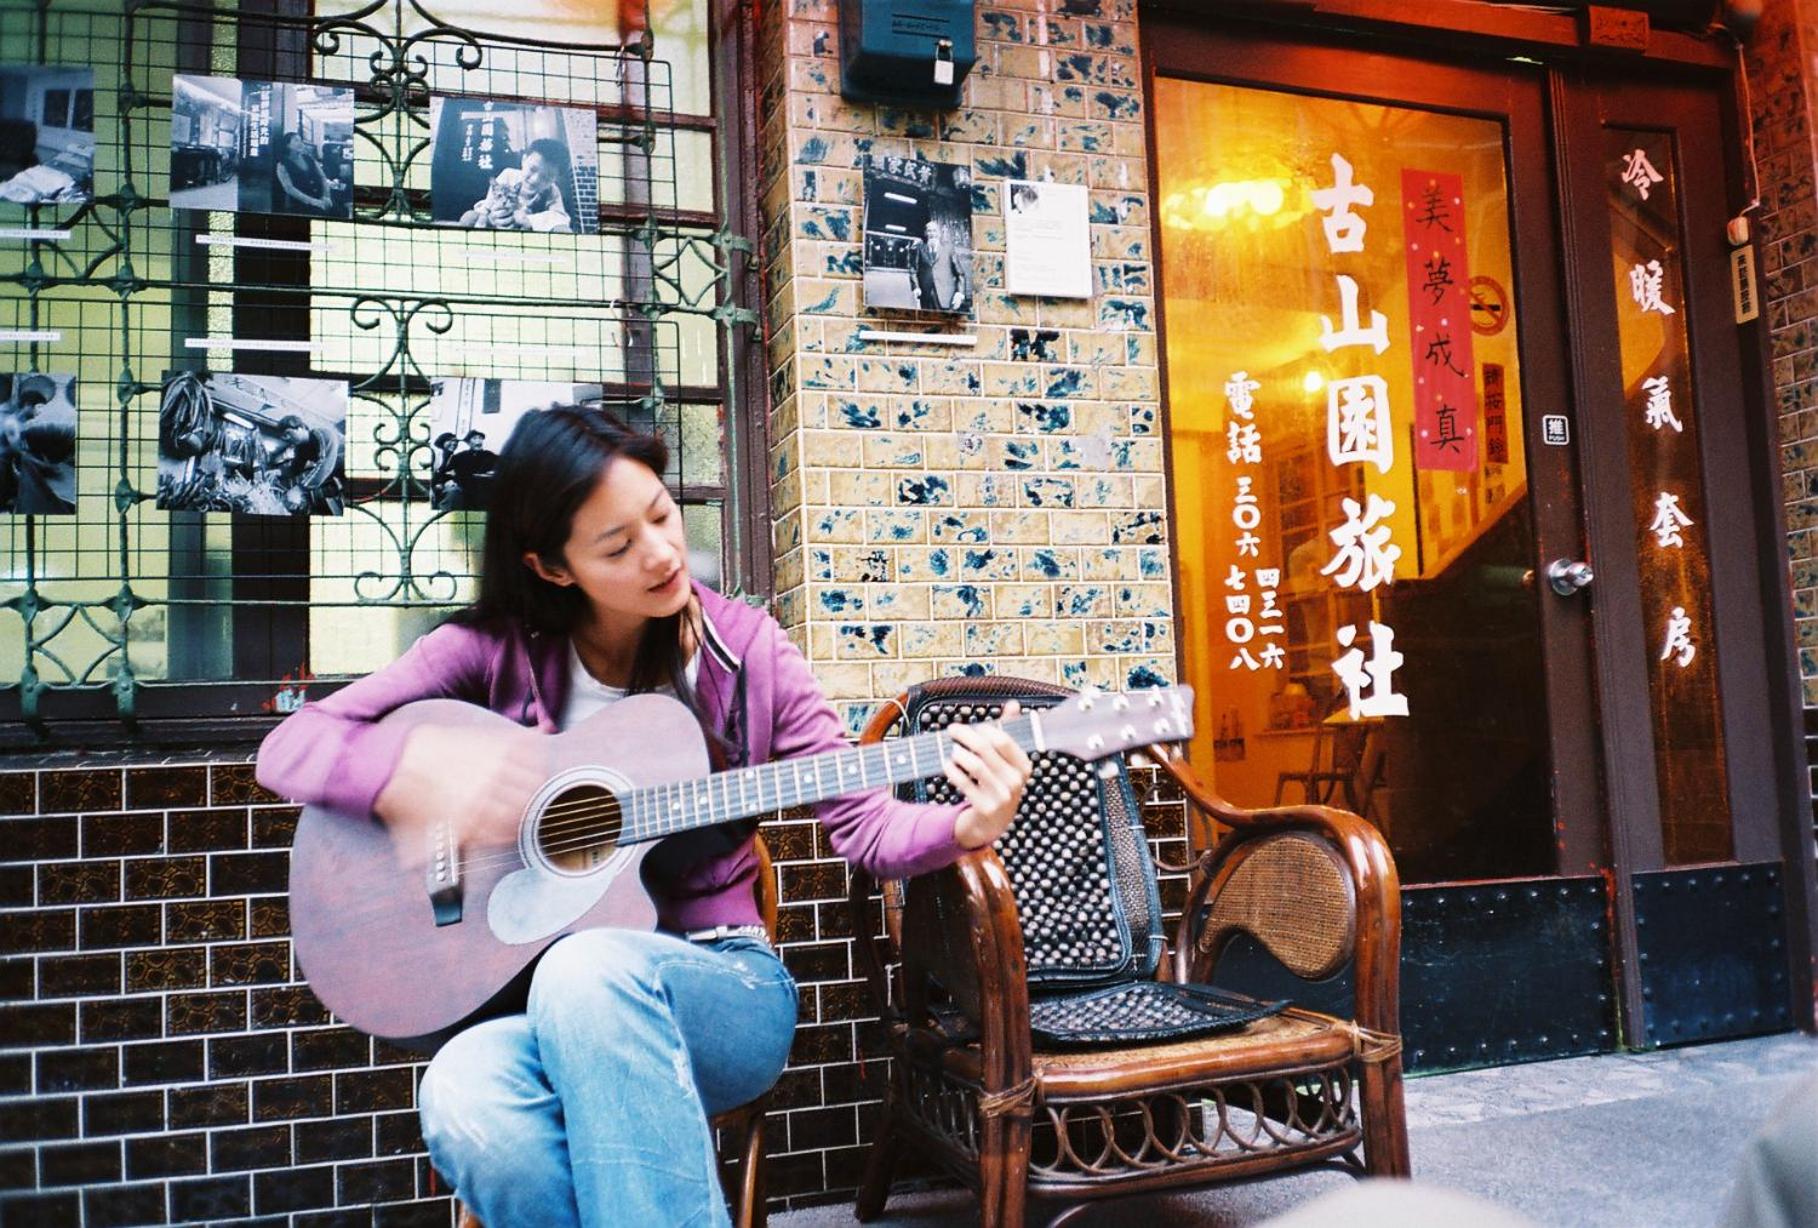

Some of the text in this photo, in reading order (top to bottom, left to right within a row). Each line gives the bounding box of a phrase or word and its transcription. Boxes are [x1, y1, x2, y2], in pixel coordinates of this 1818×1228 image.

[1224, 371, 1262, 464] 電話
[1311, 153, 1409, 720] 古山園旅社
[1416, 188, 1466, 453] 美夢成真
[1548, 418, 1563, 434] 推
[1622, 149, 1697, 668] 冷暖氣套房
